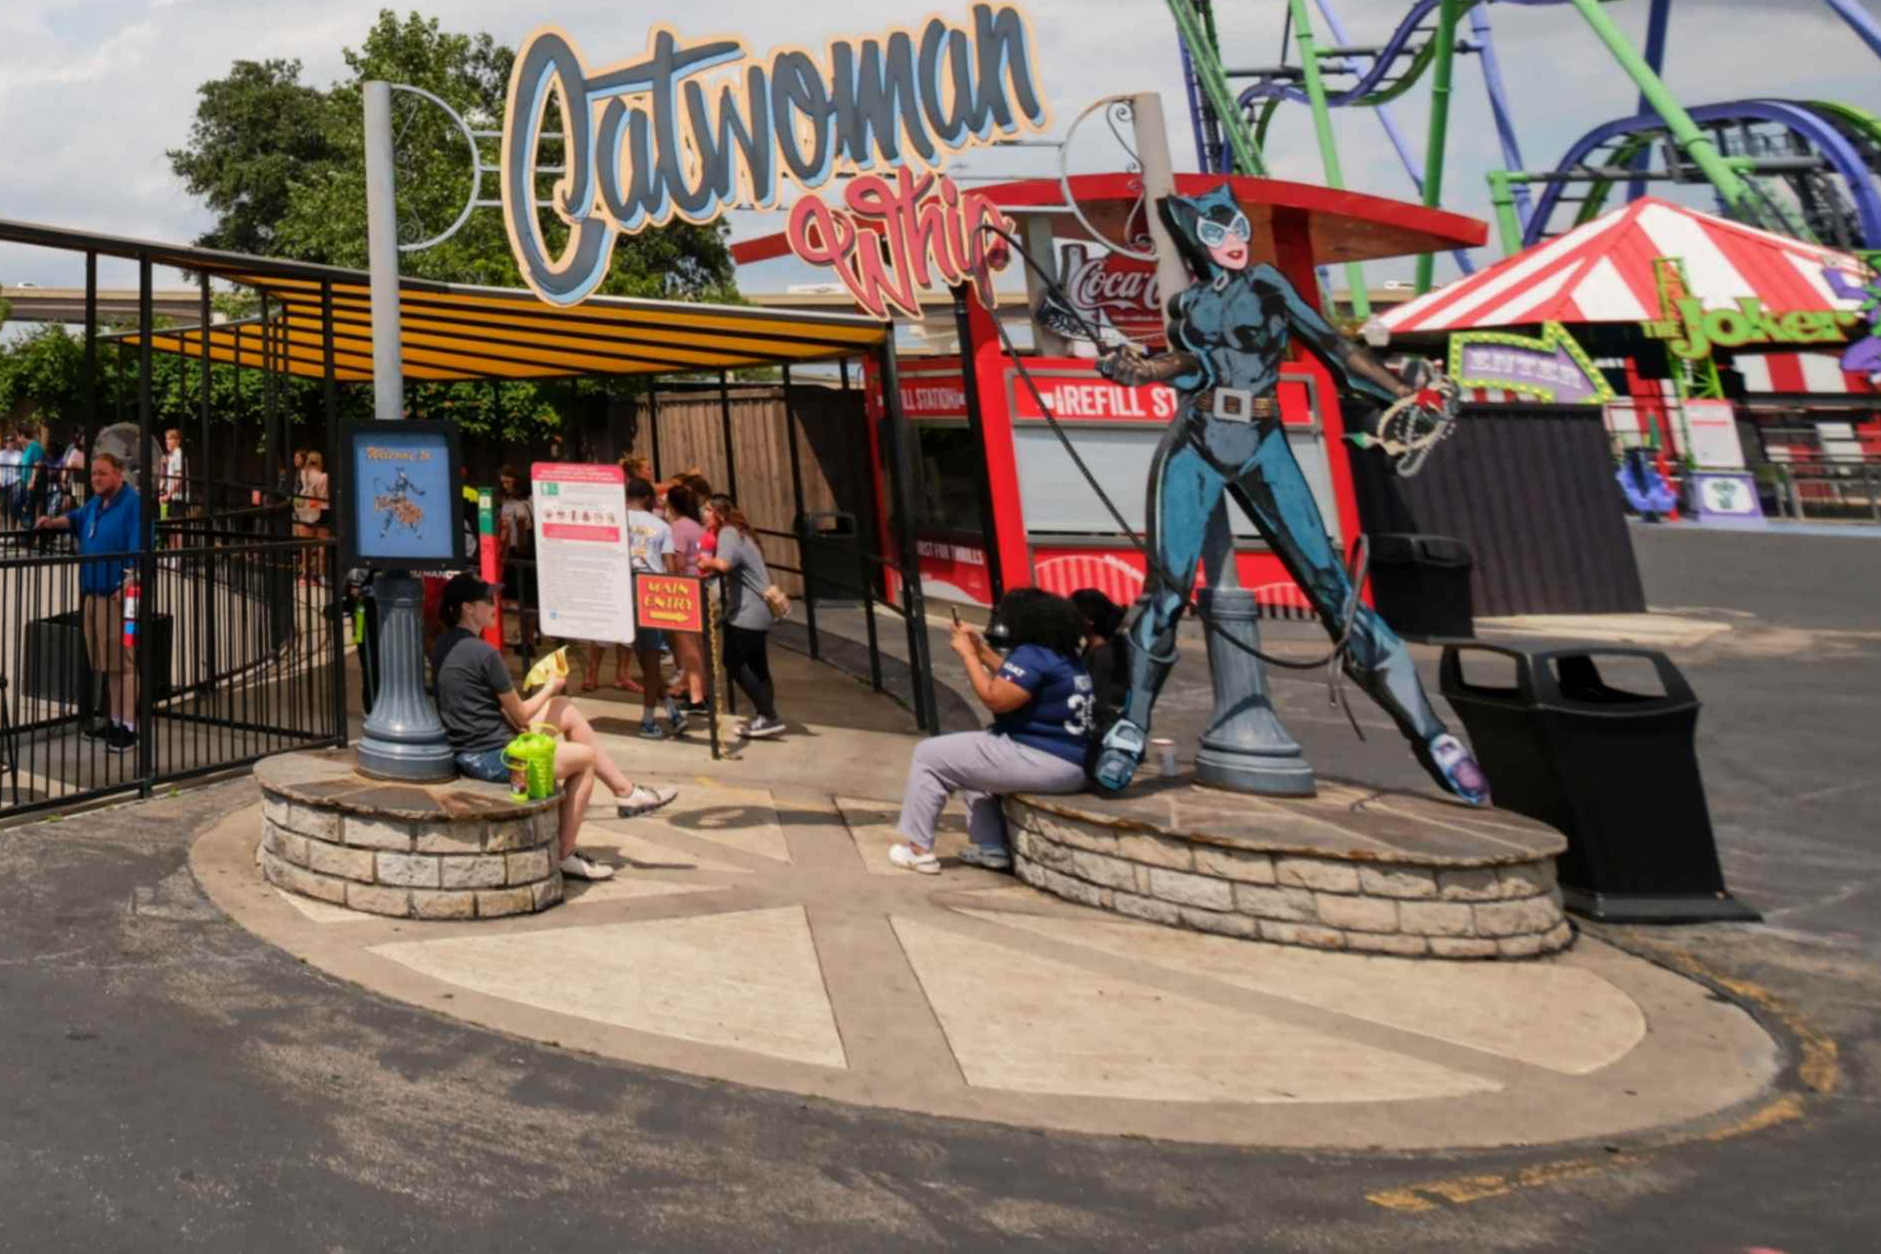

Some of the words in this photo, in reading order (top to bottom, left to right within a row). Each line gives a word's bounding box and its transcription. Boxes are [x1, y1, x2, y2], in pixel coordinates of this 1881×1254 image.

[504, 0, 1050, 306] Catwoman
[788, 166, 1013, 320] Whip
[1071, 259, 1160, 309] Coca-C
[1669, 296, 1859, 359] Joker
[1469, 350, 1583, 389] ENTER
[1067, 384, 1146, 417] REFILL
[644, 594, 694, 611] ENTRY
[646, 582, 689, 595] MAIN
